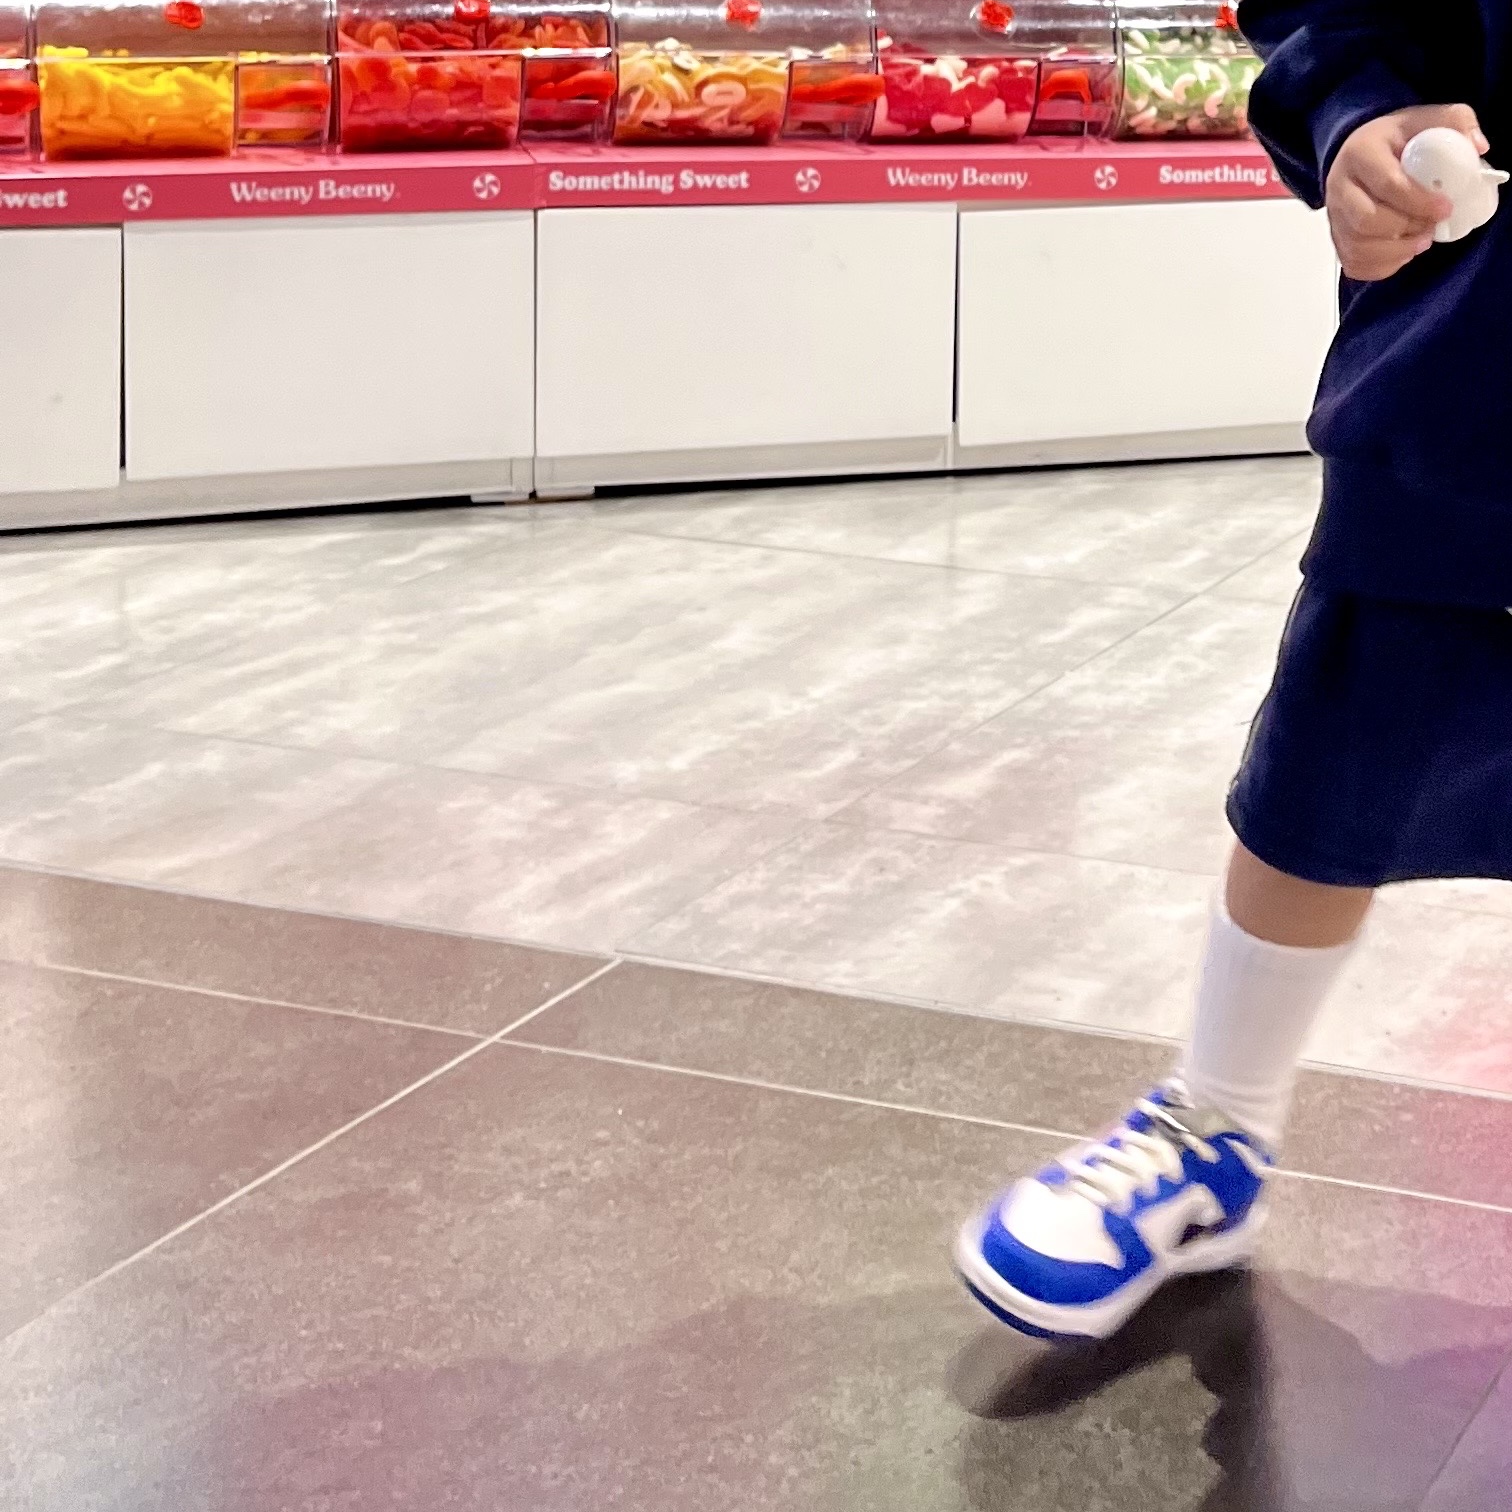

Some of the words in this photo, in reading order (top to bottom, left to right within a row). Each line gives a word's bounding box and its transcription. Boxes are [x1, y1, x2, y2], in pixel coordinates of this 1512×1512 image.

[549, 169, 674, 194] Something
[680, 169, 749, 190] Sweet
[887, 167, 958, 190] Weeny
[1160, 163, 1267, 187] Something
[0, 189, 69, 209] weet
[230, 181, 314, 205] Weeny
